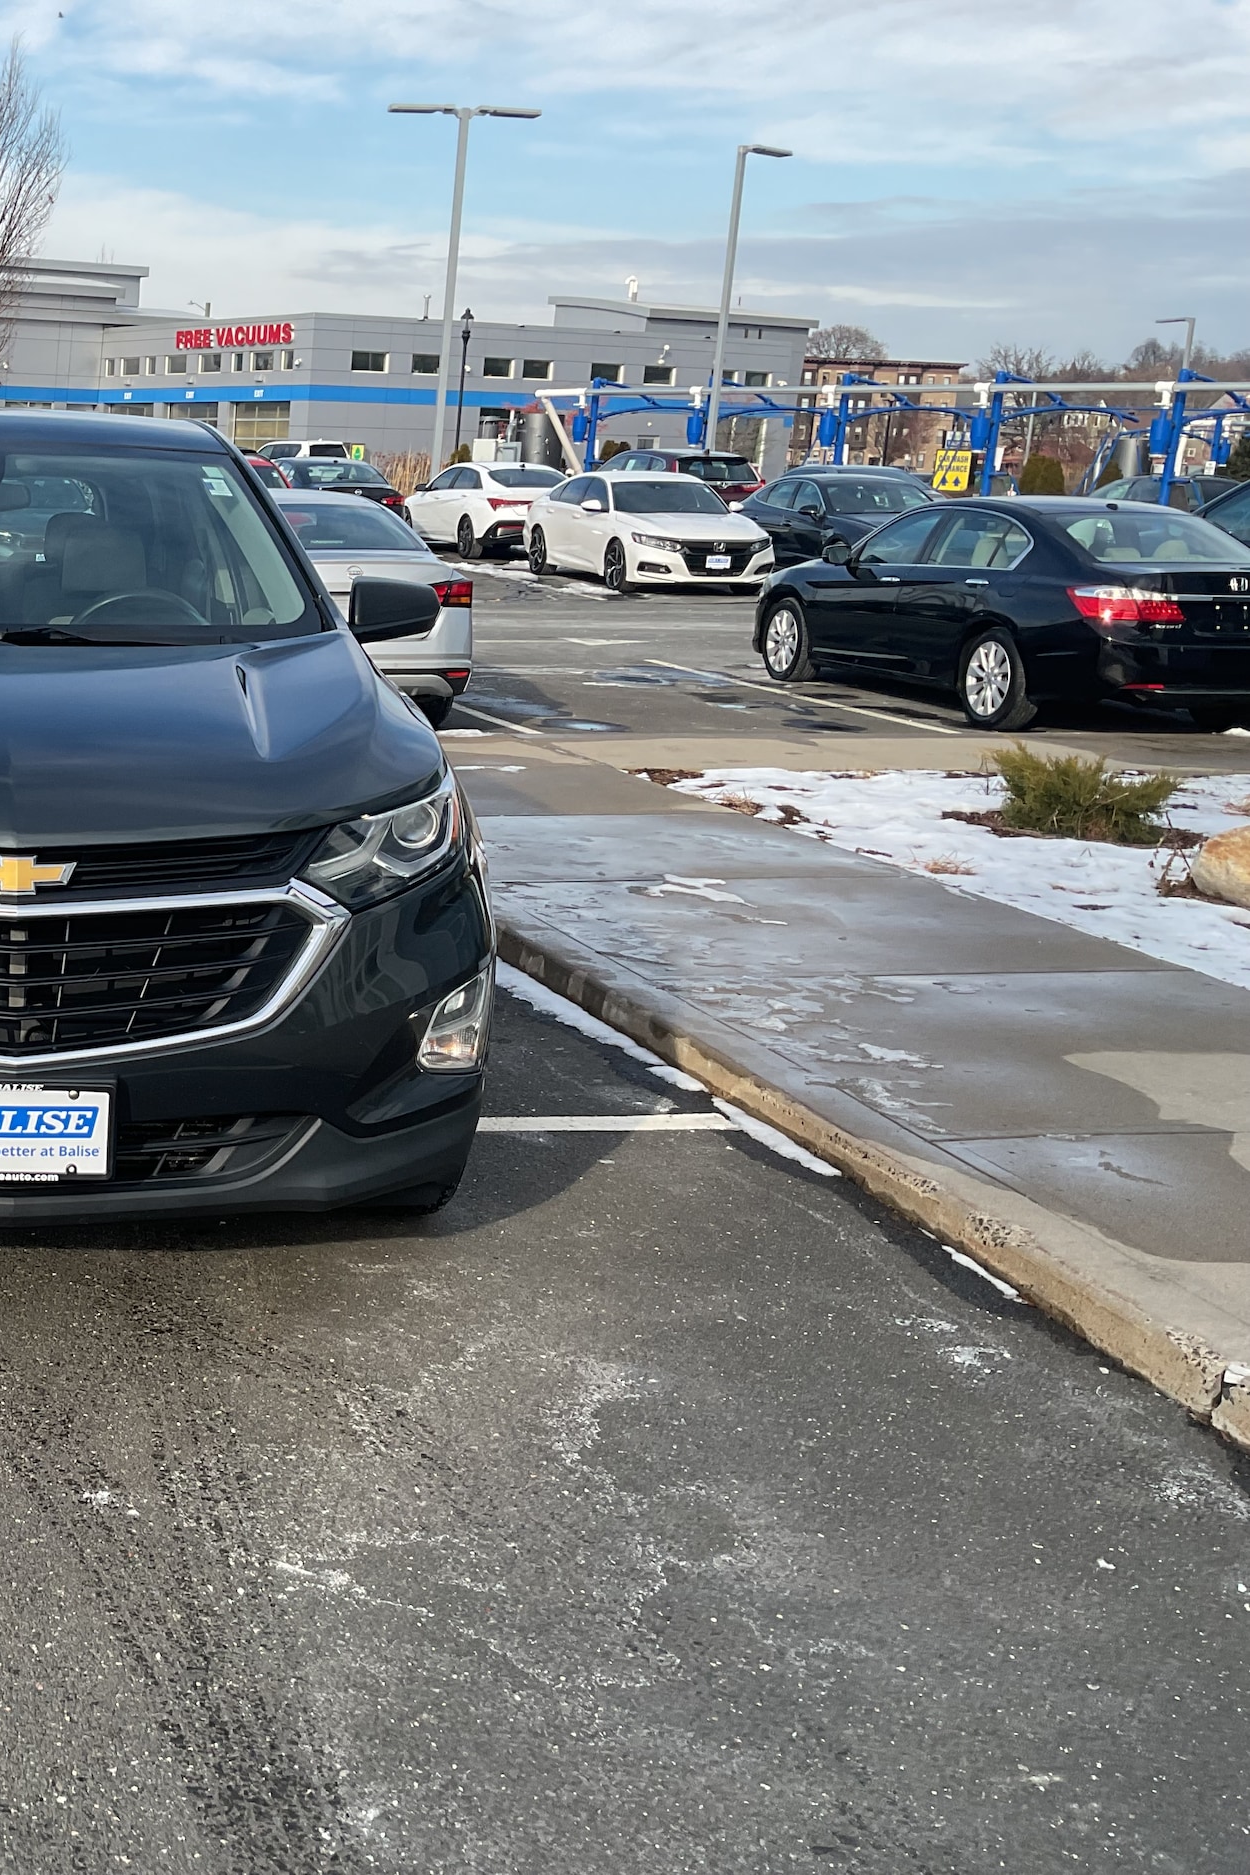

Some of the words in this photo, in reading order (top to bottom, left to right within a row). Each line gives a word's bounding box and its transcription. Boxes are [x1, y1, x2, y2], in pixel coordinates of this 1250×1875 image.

[175, 328, 214, 350] FREE
[216, 322, 295, 348] VACUUMS
[937, 464, 968, 473] NTANCE
[40, 1147, 55, 1157] at
[59, 1146, 99, 1158] Balise
